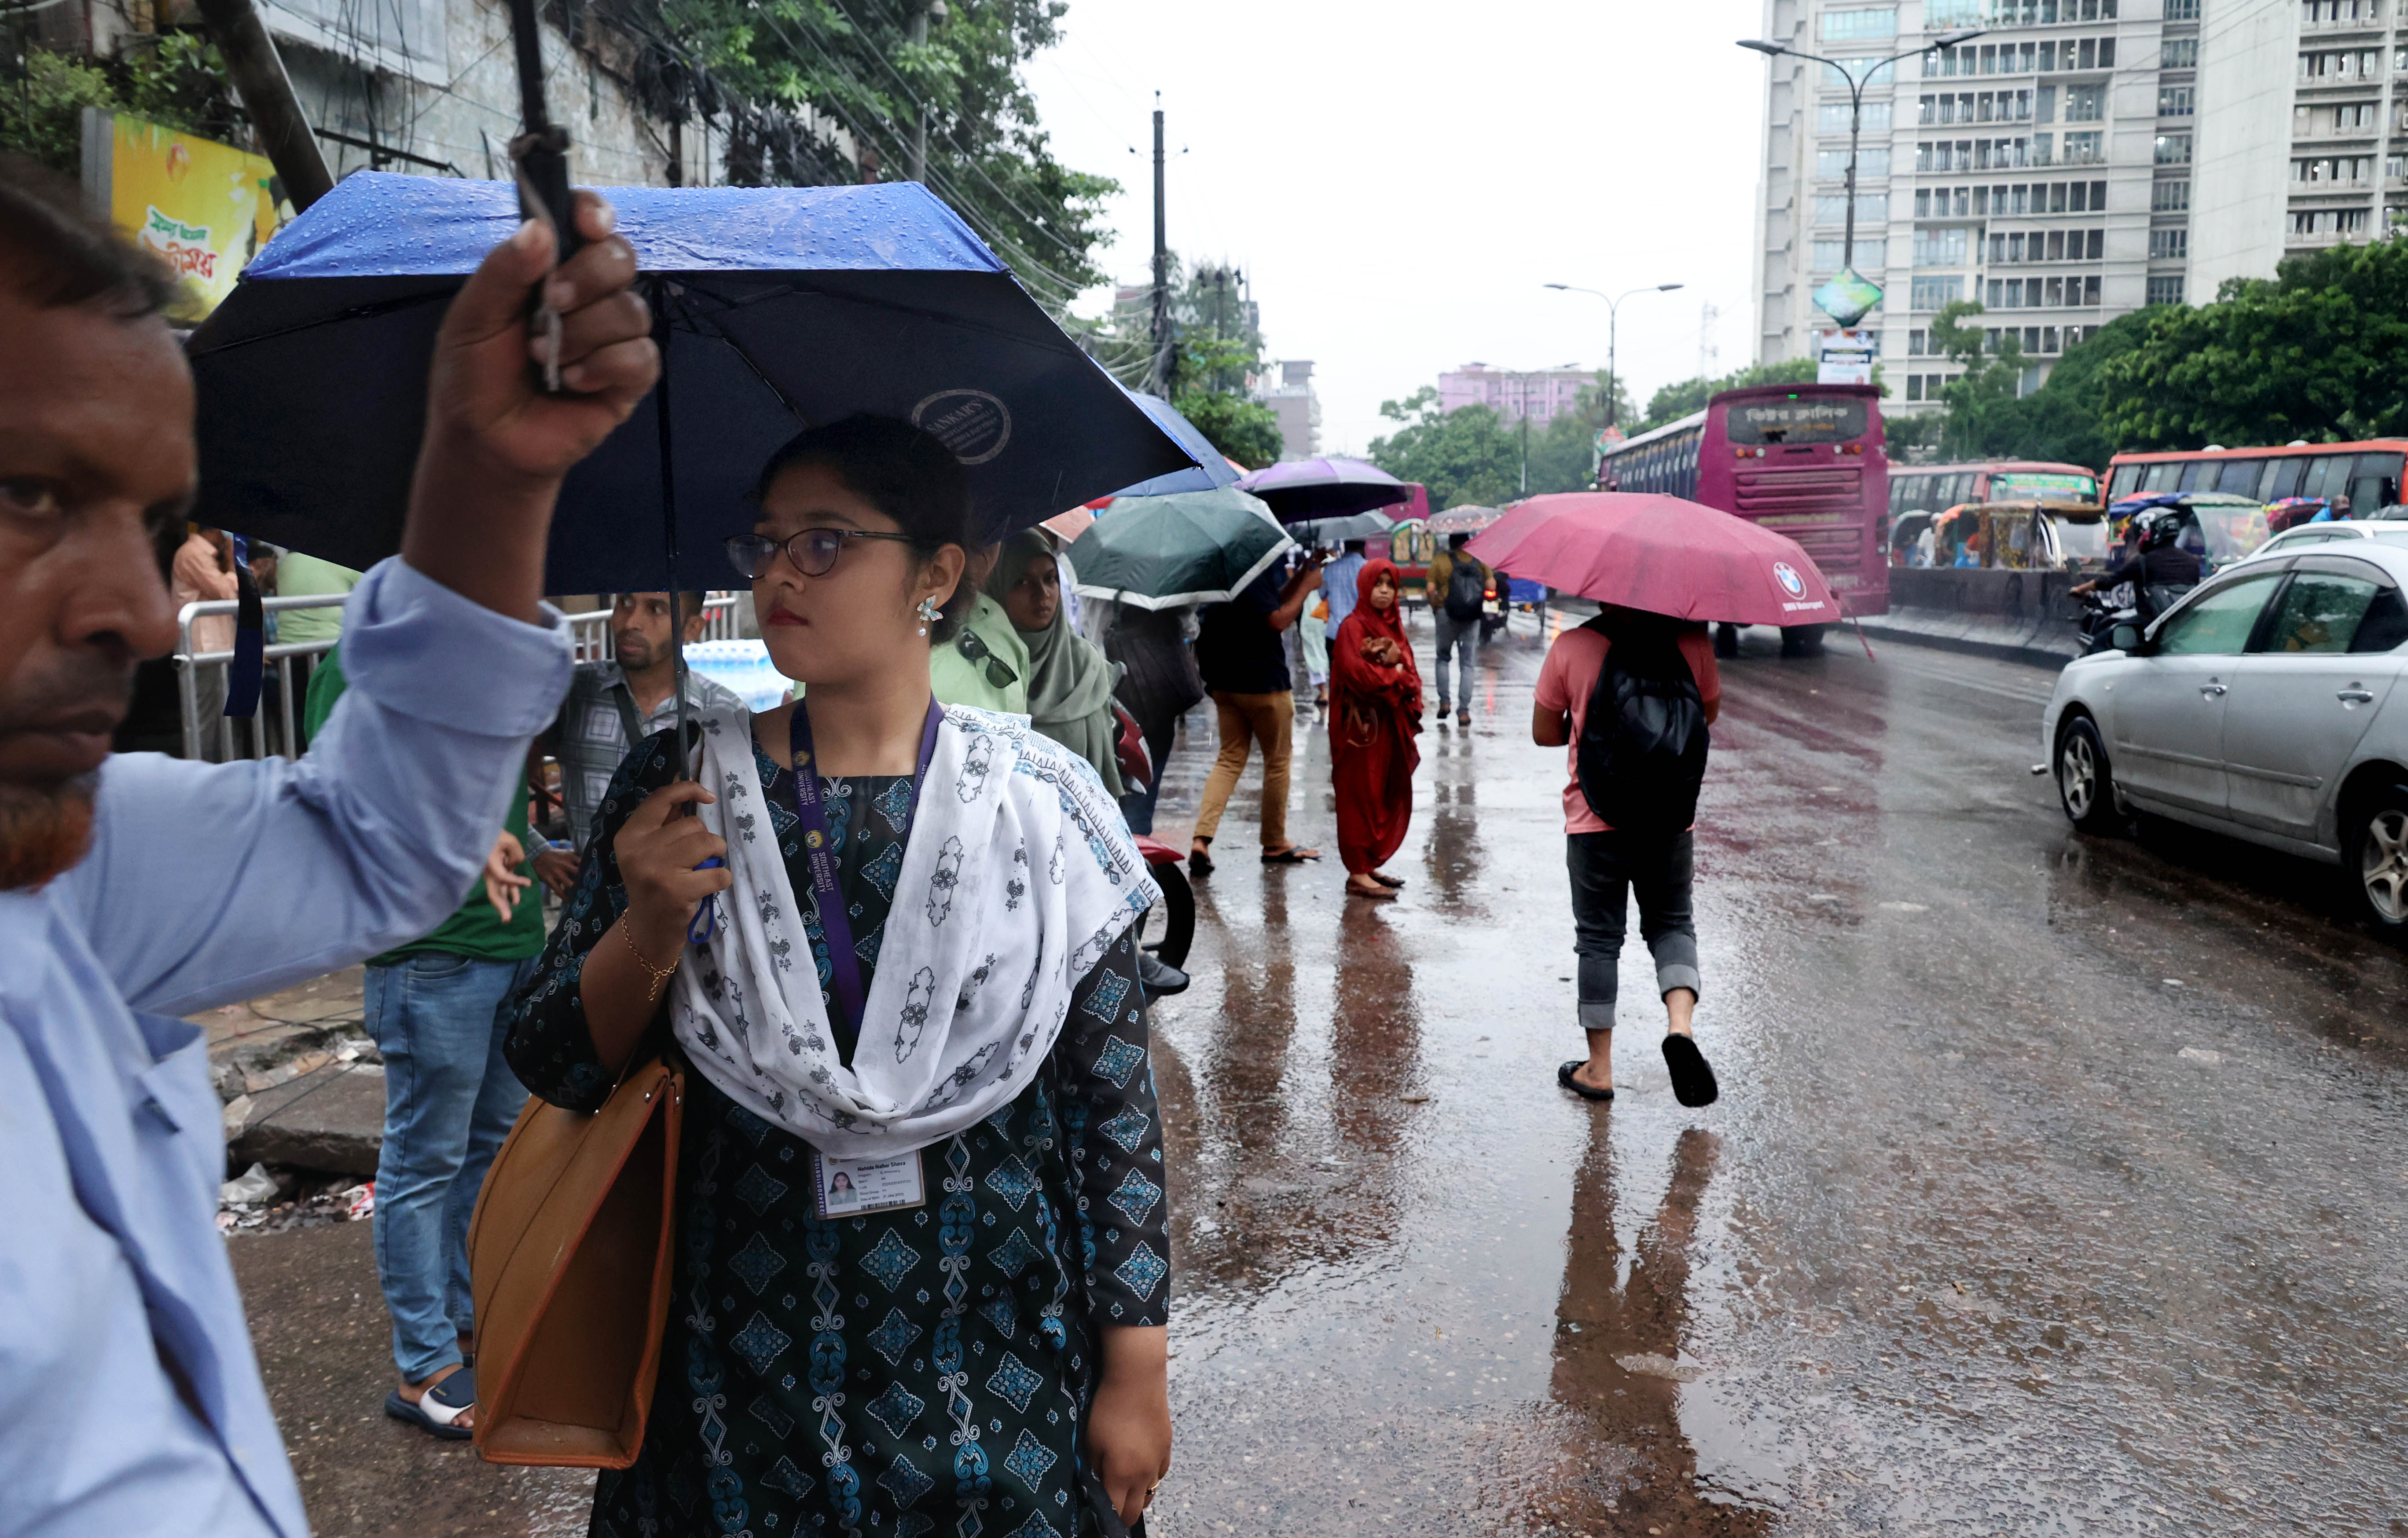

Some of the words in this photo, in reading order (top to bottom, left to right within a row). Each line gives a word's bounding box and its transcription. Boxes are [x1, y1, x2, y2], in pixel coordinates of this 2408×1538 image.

[797, 770, 808, 806] UNIVERSITY
[811, 853, 826, 892] UNIVERSITY
[819, 852, 834, 890] SOUTHEAST
